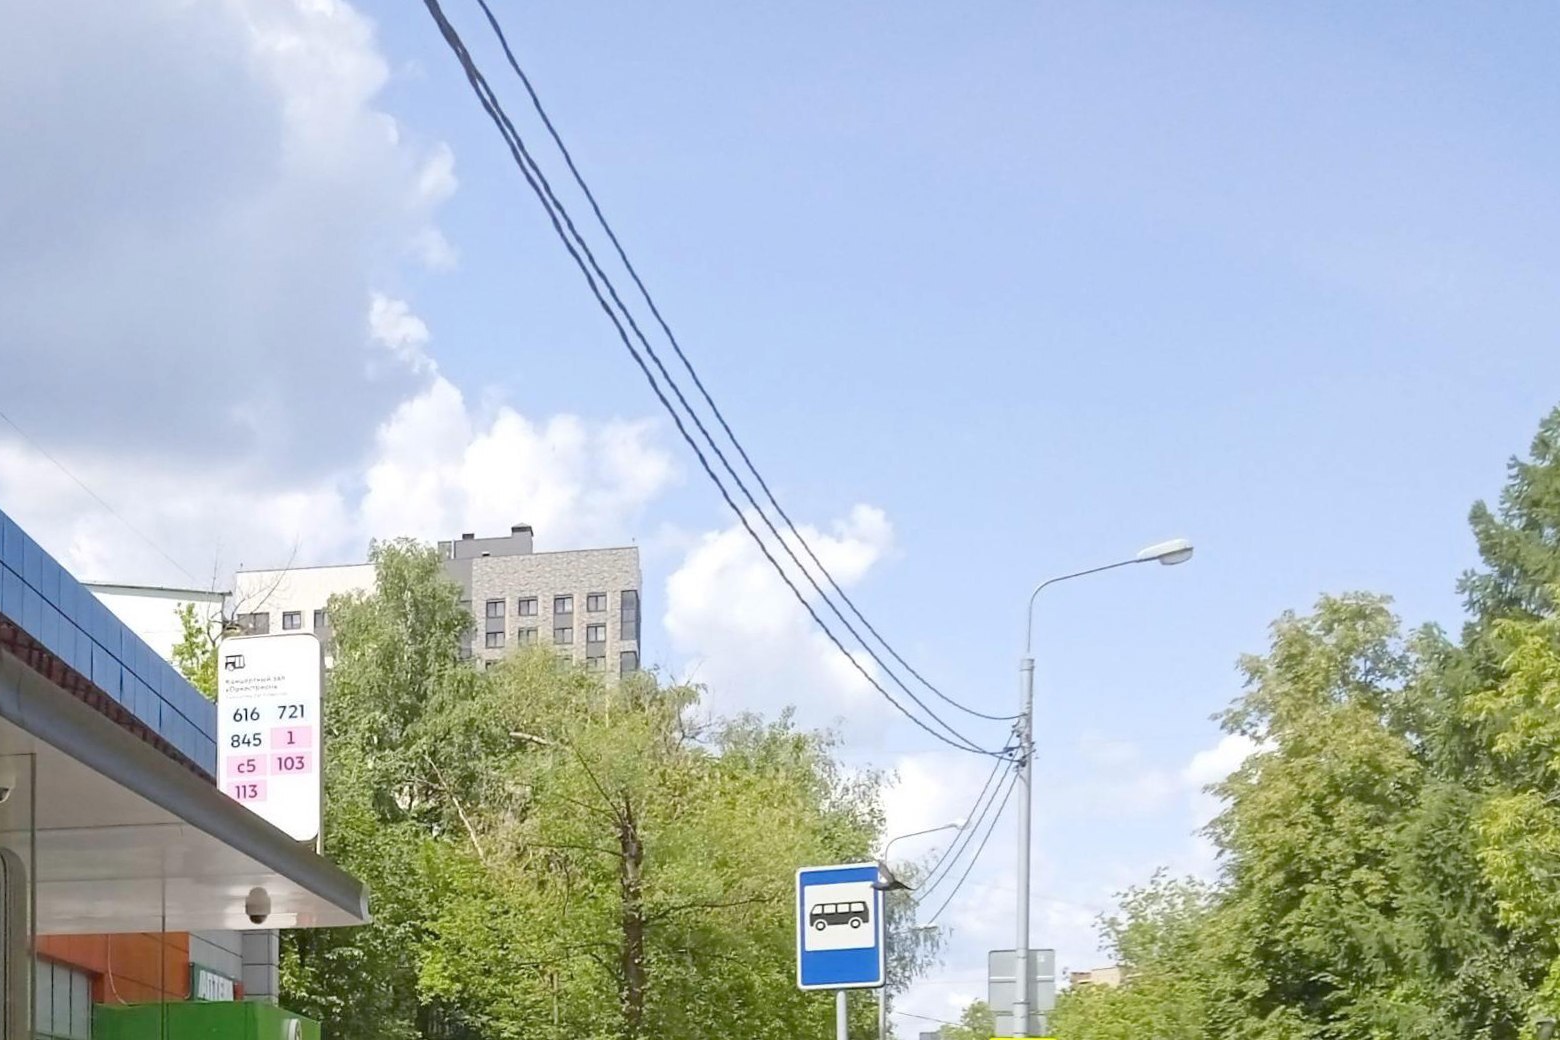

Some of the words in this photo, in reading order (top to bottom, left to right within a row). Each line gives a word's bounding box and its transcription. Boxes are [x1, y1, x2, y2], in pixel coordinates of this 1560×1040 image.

[233, 706, 260, 722] 616
[277, 704, 305, 720] 721
[230, 732, 262, 748] 845
[287, 730, 295, 745] 1
[277, 755, 305, 771] 103
[235, 784, 258, 799] 113
